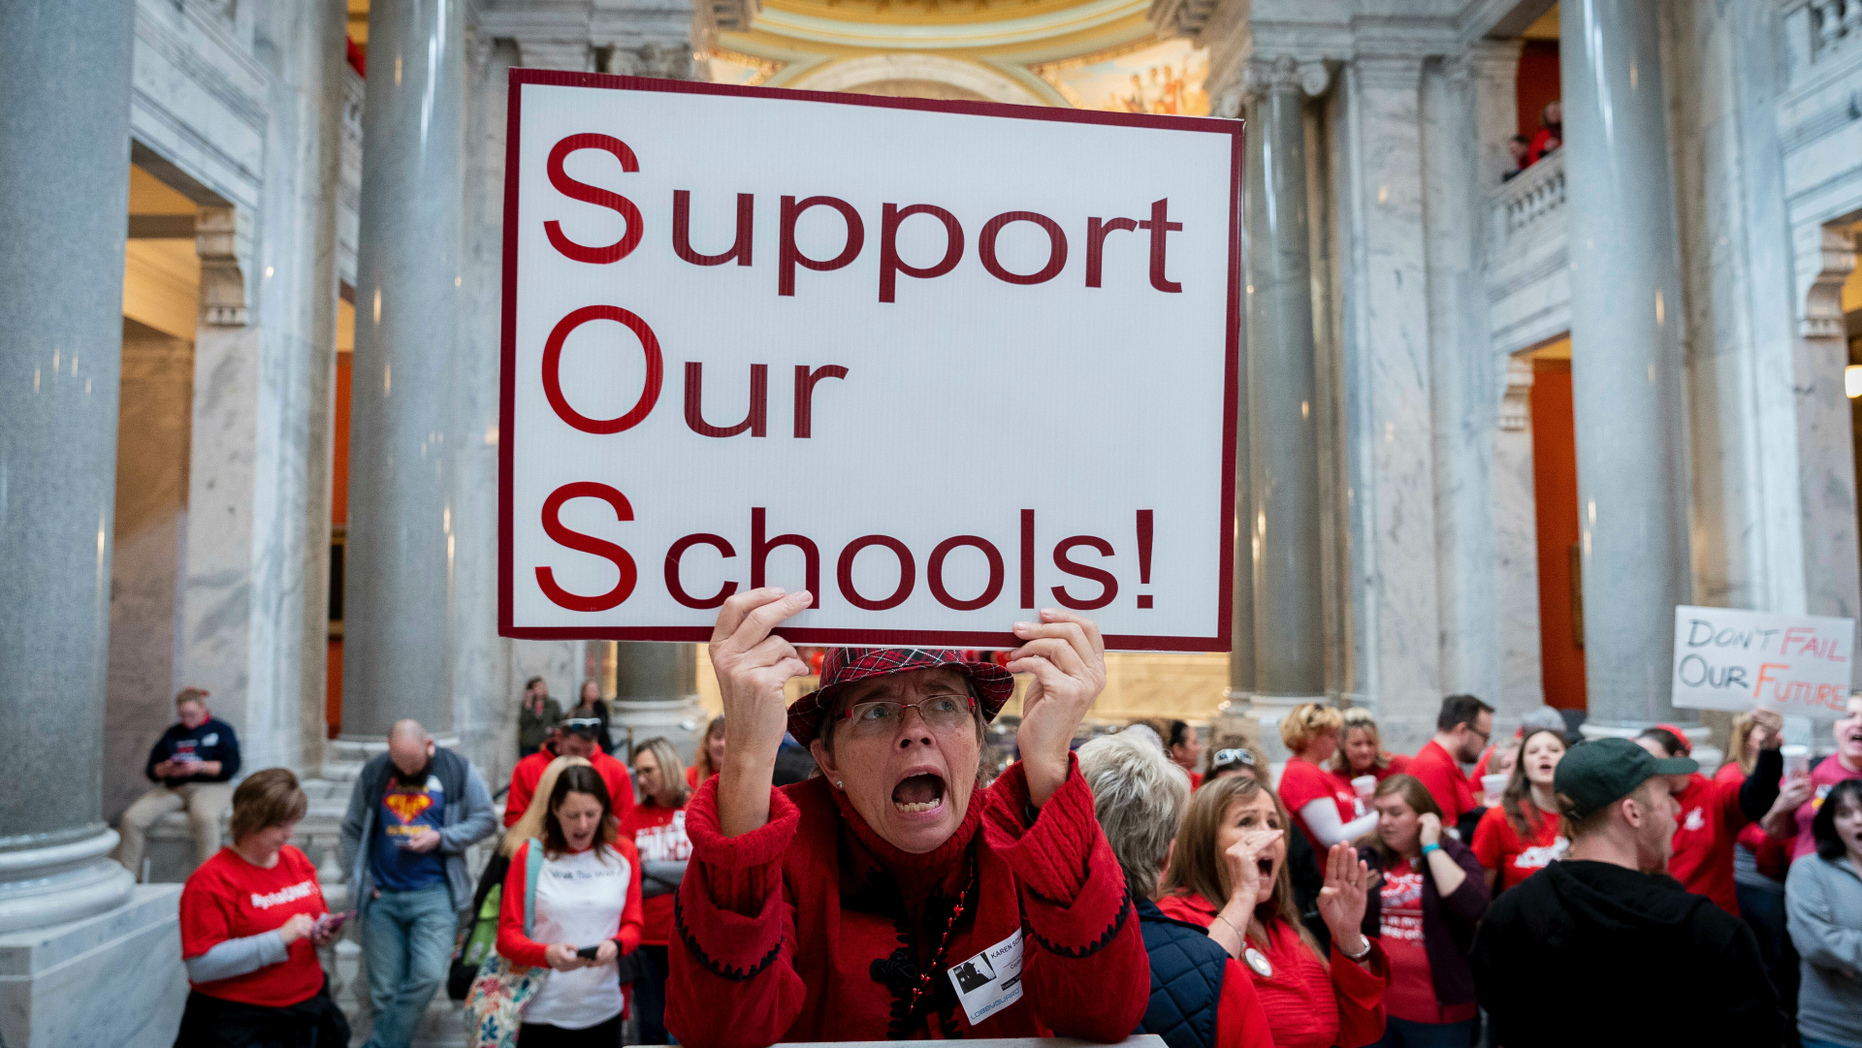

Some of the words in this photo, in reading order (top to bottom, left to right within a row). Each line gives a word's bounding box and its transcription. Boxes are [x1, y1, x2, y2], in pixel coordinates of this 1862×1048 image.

[543, 132, 1184, 303] Support
[541, 304, 849, 439] Our
[534, 480, 1155, 613] Schools!
[1678, 653, 1749, 689] OUR
[1753, 662, 1850, 711] FUTURE
[1779, 627, 1848, 662] FAIL
[990, 943, 1013, 959] KAREN
